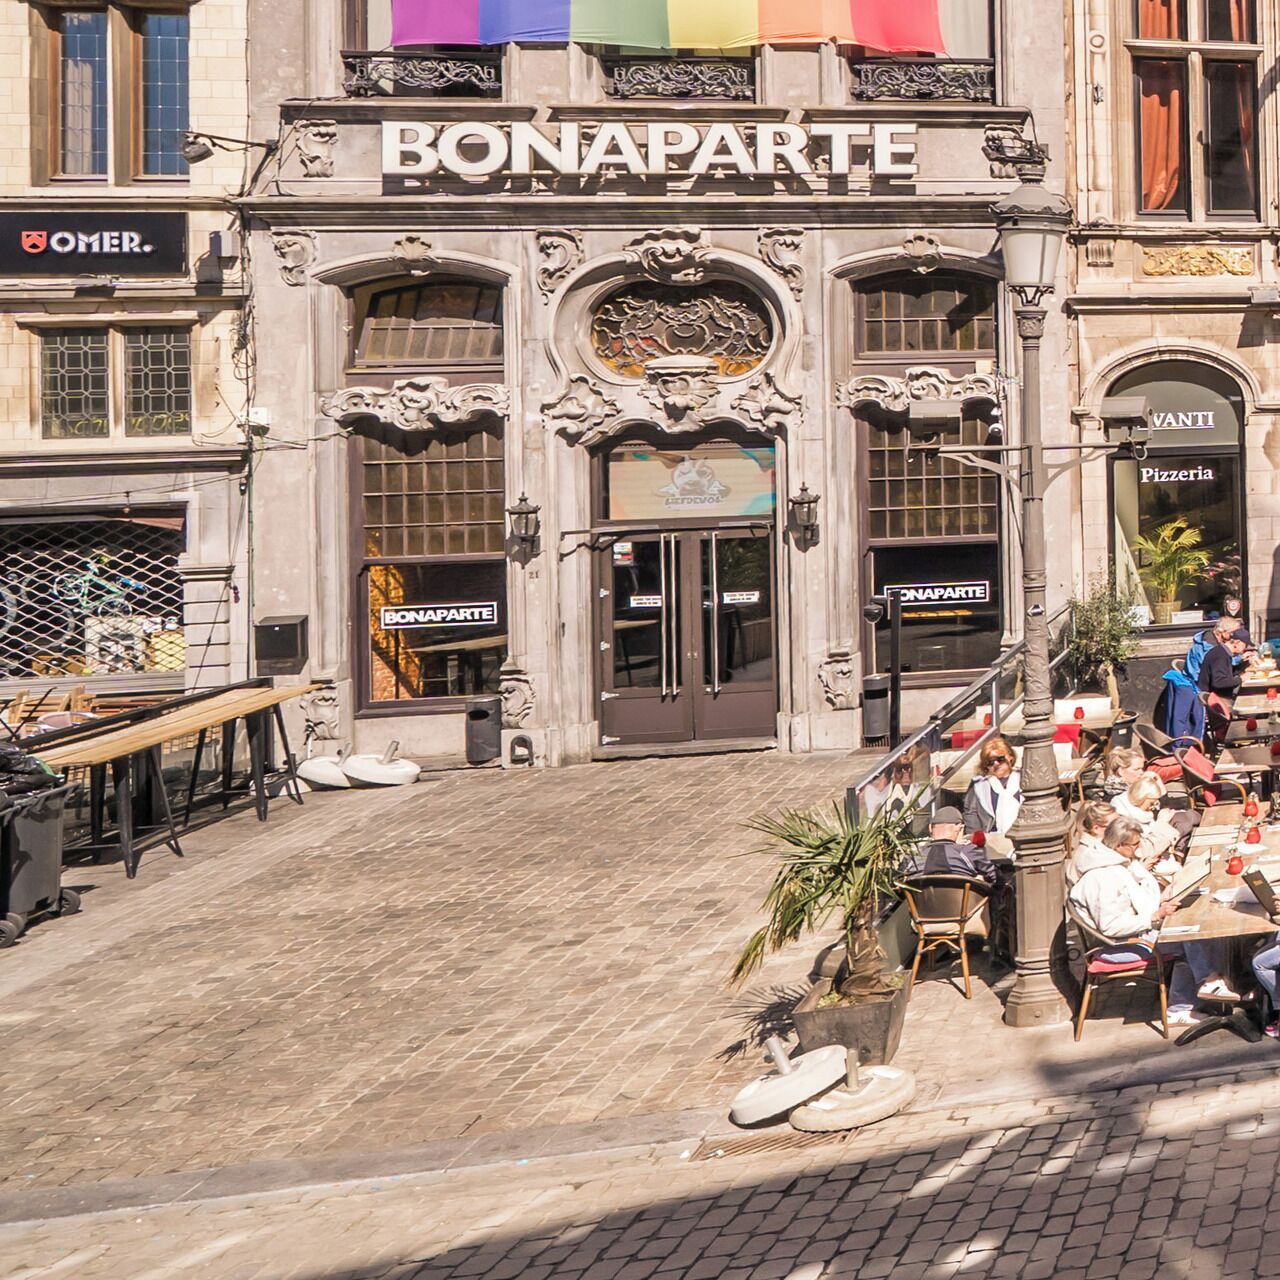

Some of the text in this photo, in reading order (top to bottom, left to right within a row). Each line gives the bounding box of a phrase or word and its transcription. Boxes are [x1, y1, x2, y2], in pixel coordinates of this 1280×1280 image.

[382, 121, 919, 175] BONAPARTE
[1152, 411, 1215, 427] VANTI
[1140, 466, 1214, 483] Pizzeria
[900, 585, 986, 601] ONAPARTE
[384, 606, 494, 624] BONAPARTE
